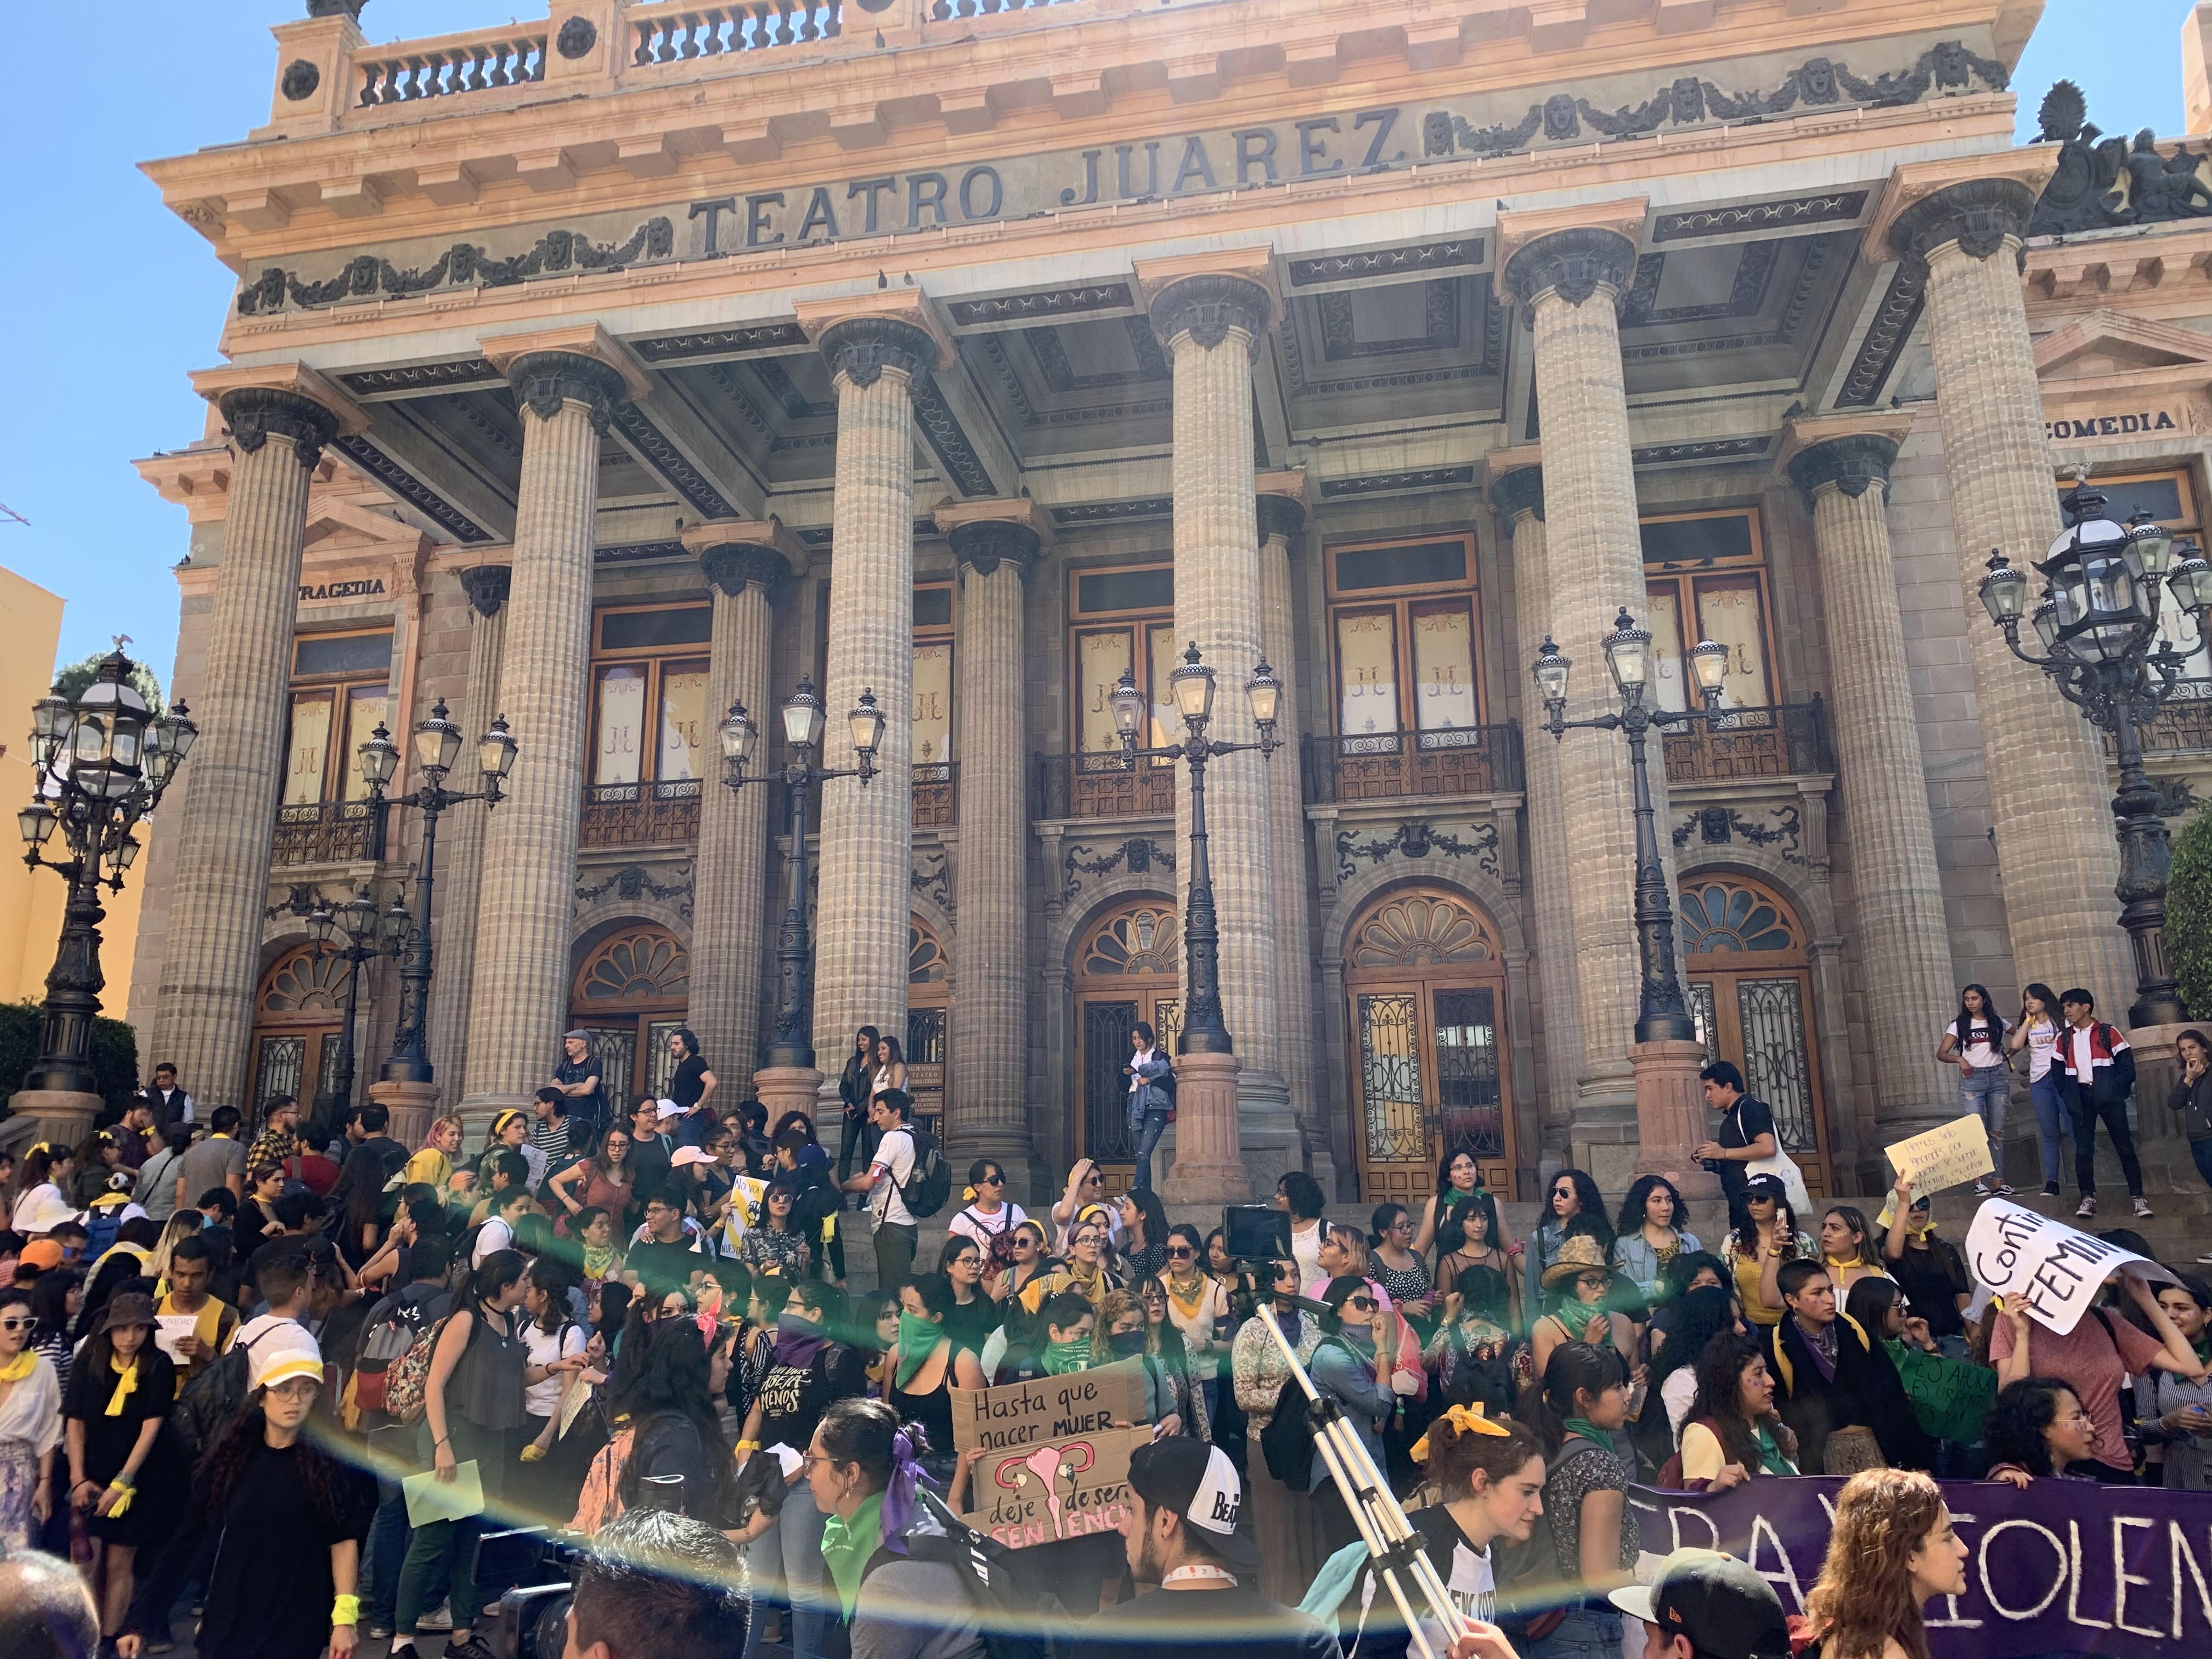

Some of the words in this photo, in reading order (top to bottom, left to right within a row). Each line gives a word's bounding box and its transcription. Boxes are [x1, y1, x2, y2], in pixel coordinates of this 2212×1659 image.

[689, 165, 1005, 253] TEATRO
[1060, 108, 1406, 208] JUAREZ
[760, 1374, 812, 1392] ABEJA
[1912, 1379, 1929, 1400] ES
[1915, 1355, 1943, 1383] ES
[1946, 1364, 1993, 1392] AHORA
[761, 1389, 799, 1413] MENOS
[975, 1384, 1047, 1421] Hasta
[1057, 1383, 1098, 1415] que
[980, 1424, 1040, 1450] nacer
[1053, 1410, 1115, 1437] MUJER
[989, 1495, 1036, 1525] deje
[1065, 1479, 1090, 1511] de
[1094, 1483, 1128, 1504] ser
